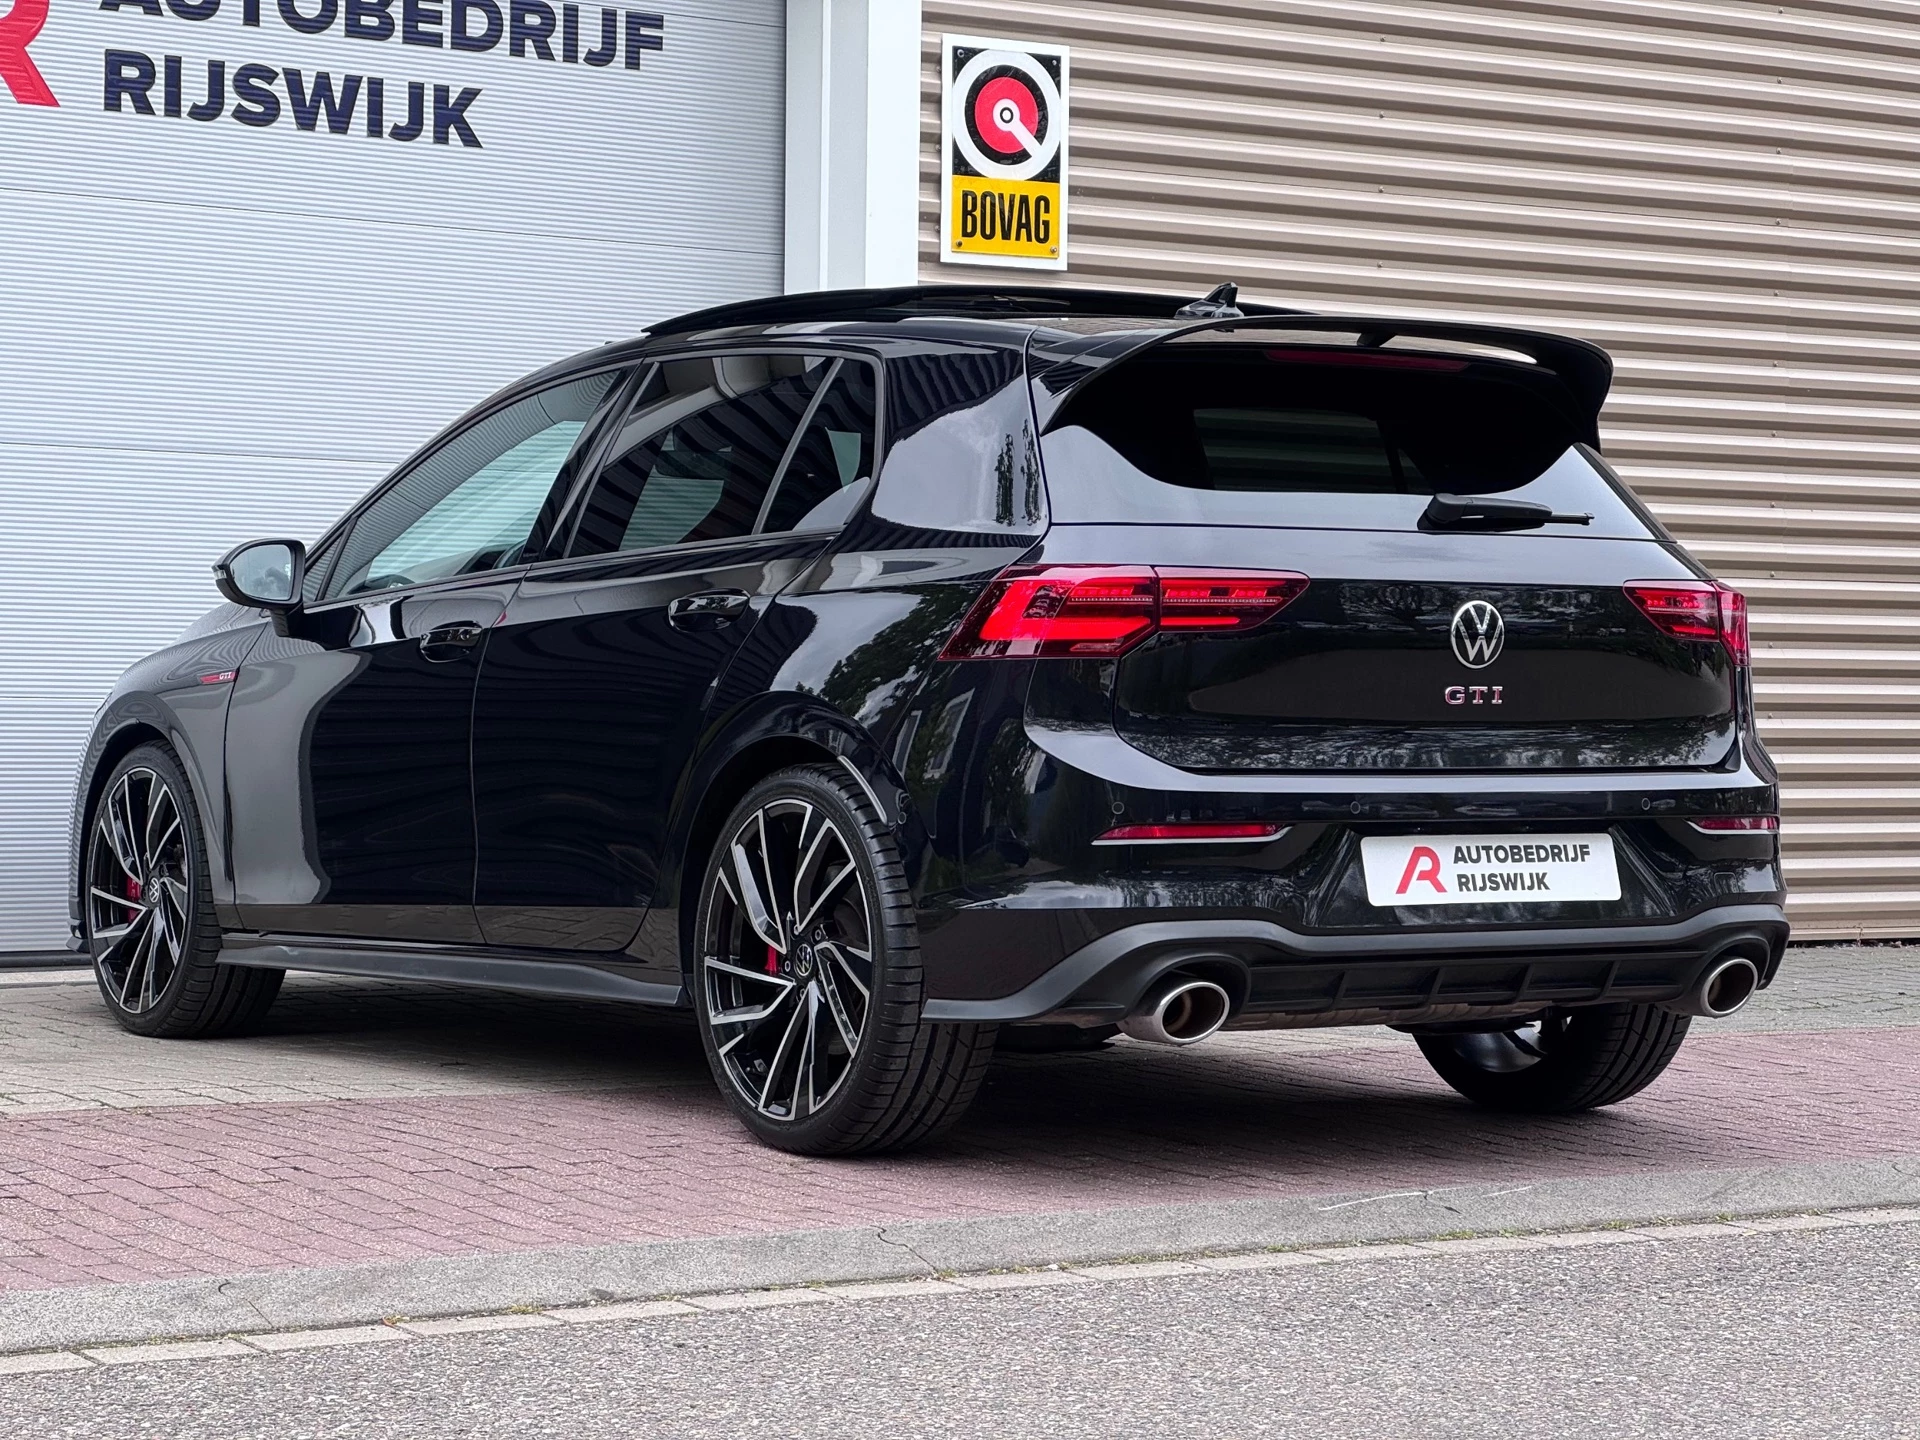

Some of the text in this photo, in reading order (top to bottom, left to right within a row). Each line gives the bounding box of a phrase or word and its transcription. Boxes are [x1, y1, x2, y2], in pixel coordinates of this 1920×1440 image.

[103, 48, 484, 148] RIJSWIJK
[961, 189, 1051, 244] BOVAG
[219, 671, 232, 680] GTI
[1445, 685, 1503, 705] GTI
[1453, 844, 1591, 864] AUTOBEDRIJF
[1456, 872, 1550, 892] RIJSWIJK
